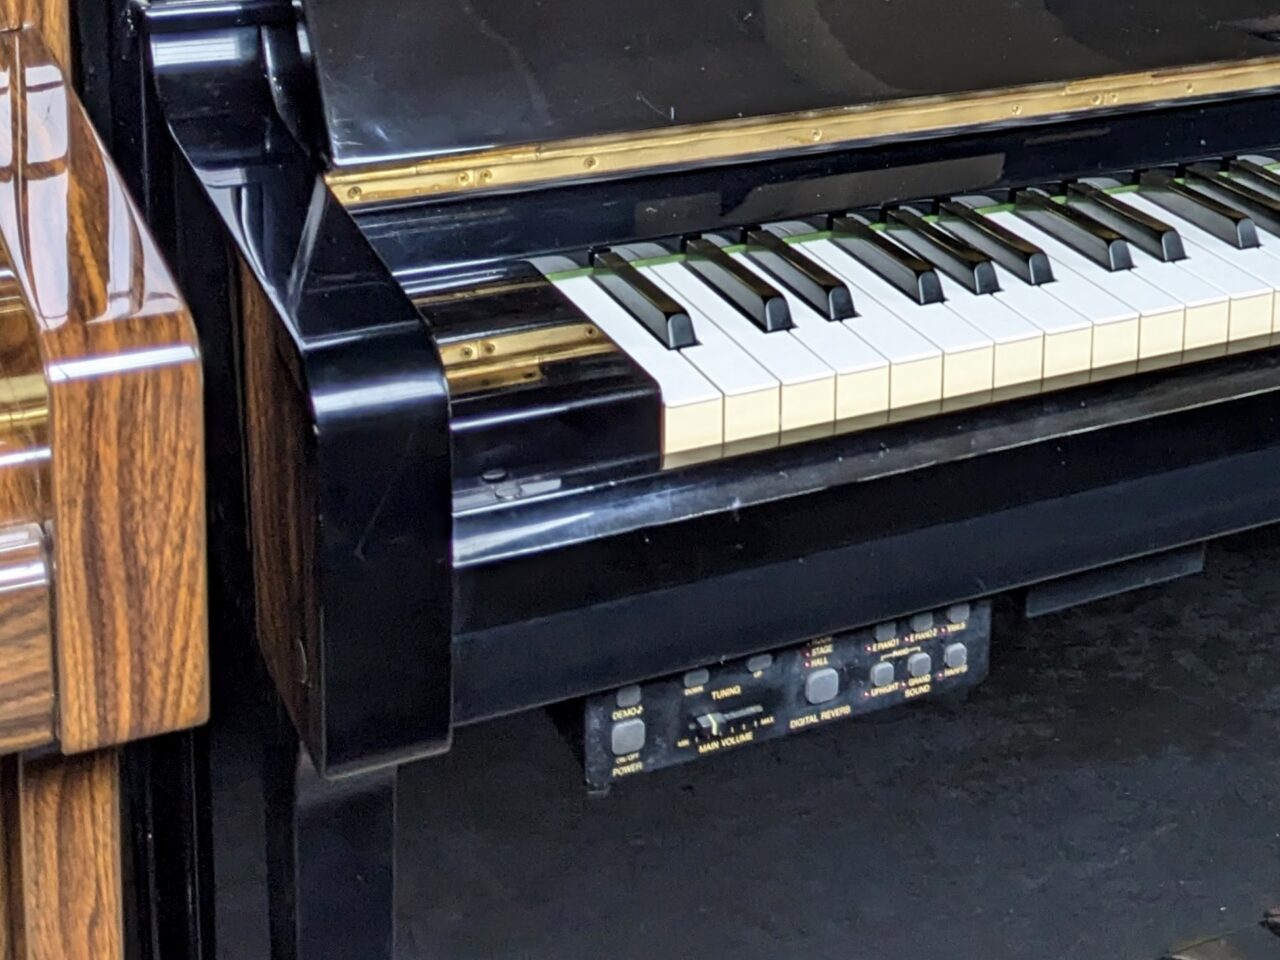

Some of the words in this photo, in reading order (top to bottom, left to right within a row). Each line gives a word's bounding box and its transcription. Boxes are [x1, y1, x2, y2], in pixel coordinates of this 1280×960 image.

[811, 644, 833, 657] STAGE
[811, 656, 829, 668] HALL
[907, 673, 932, 687] GRAND
[711, 684, 742, 700] TUNING
[870, 682, 899, 697] UPRIGHT
[904, 684, 931, 698] SOUND
[789, 714, 819, 729] DIGITAL
[820, 705, 851, 721] REVERB
[698, 740, 720, 754] MAIN
[720, 731, 753, 747] VOLUME
[612, 761, 644, 777] POWER
